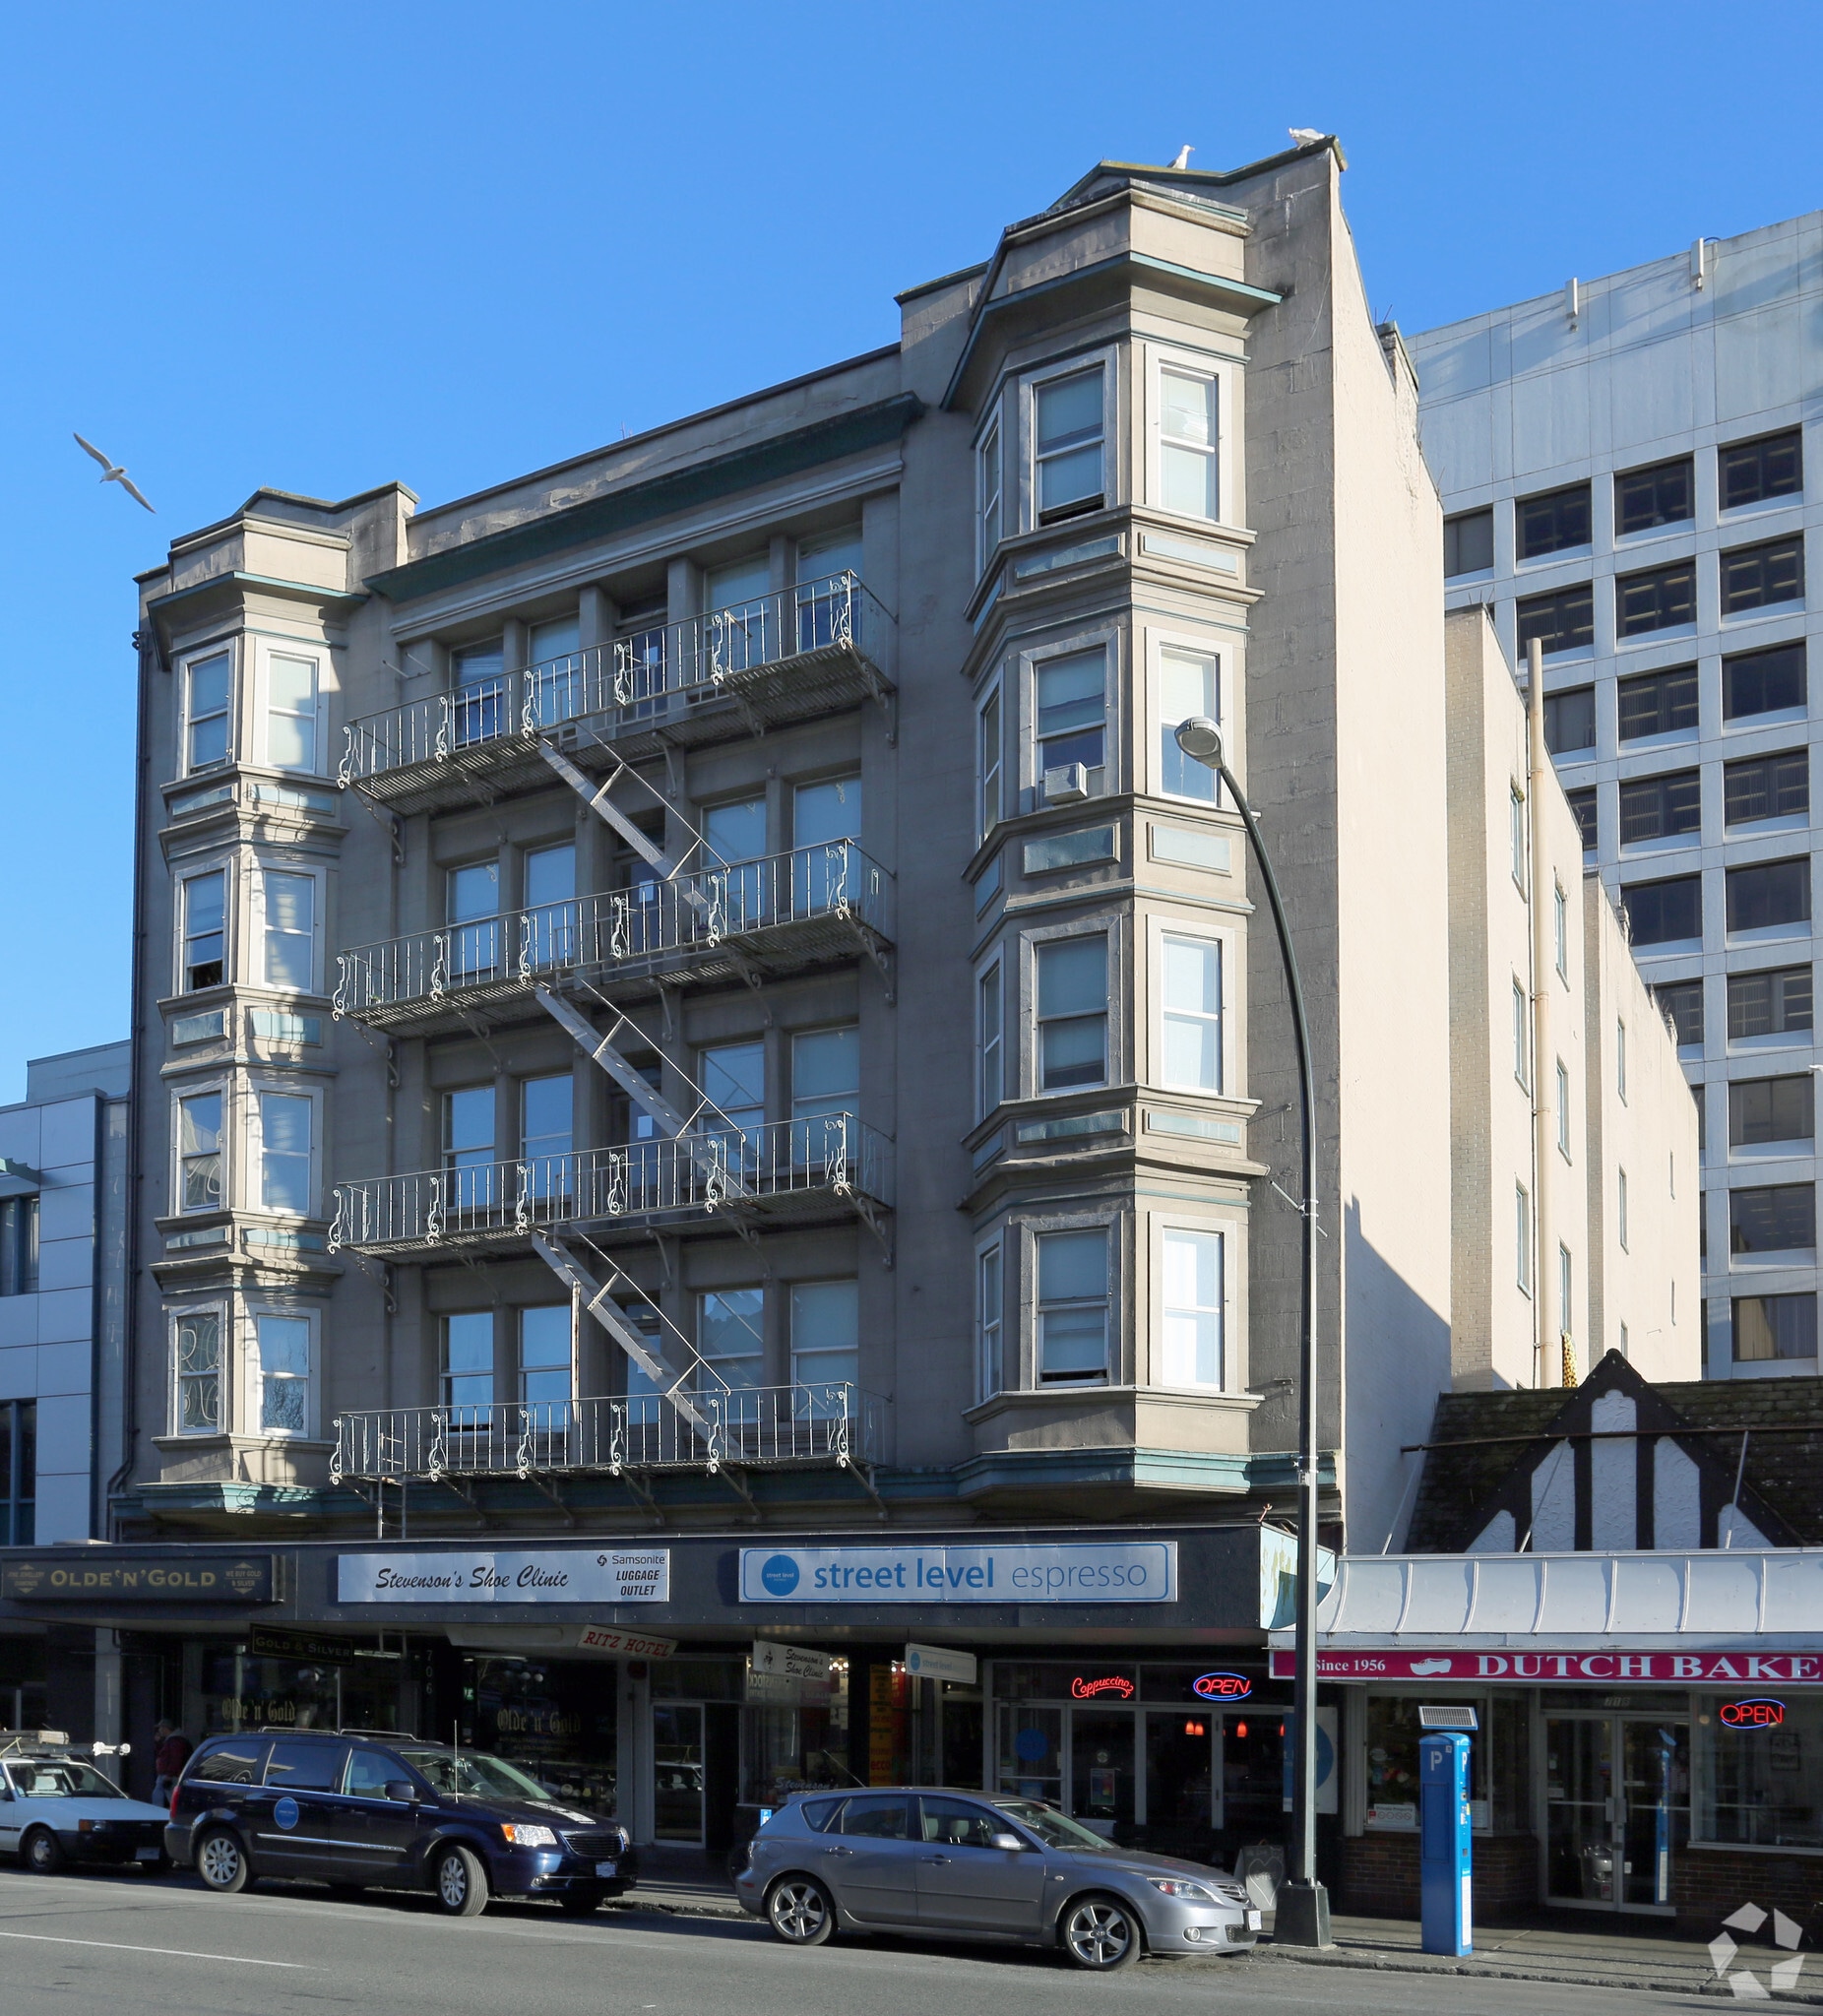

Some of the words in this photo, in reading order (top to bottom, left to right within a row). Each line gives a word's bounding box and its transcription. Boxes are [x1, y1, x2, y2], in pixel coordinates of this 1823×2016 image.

[611, 1554, 665, 1565] Samsonite
[375, 1567, 465, 1590] Stevenson's
[469, 1566, 510, 1589] Shoe
[516, 1564, 569, 1588] Clinic
[615, 1570, 660, 1582] LUGGAGE
[814, 1562, 907, 1589] street
[916, 1557, 994, 1589] level
[1012, 1563, 1148, 1594] espresso
[620, 1585, 657, 1597] OUTLET
[256, 1636, 290, 1650] GOLD
[307, 1643, 350, 1657] SILVER
[583, 1630, 620, 1649] RITZ
[623, 1638, 671, 1658] HOTEL
[786, 1648, 823, 1665] Stevenson's
[1315, 1658, 1349, 1671] Since
[1353, 1658, 1386, 1671] 1956
[803, 1665, 823, 1678] Clinic
[1476, 1655, 1656, 1678] DUTCH
[1669, 1656, 1820, 1680] BAKE
[1072, 1676, 1134, 1699] Cappuccino
[1196, 1677, 1251, 1695] OPEN
[221, 1698, 248, 1721] Olde
[268, 1701, 296, 1723] Gold
[497, 1708, 527, 1732] Olde
[548, 1711, 582, 1734] Gold
[1721, 1703, 1784, 1725] OPEN
